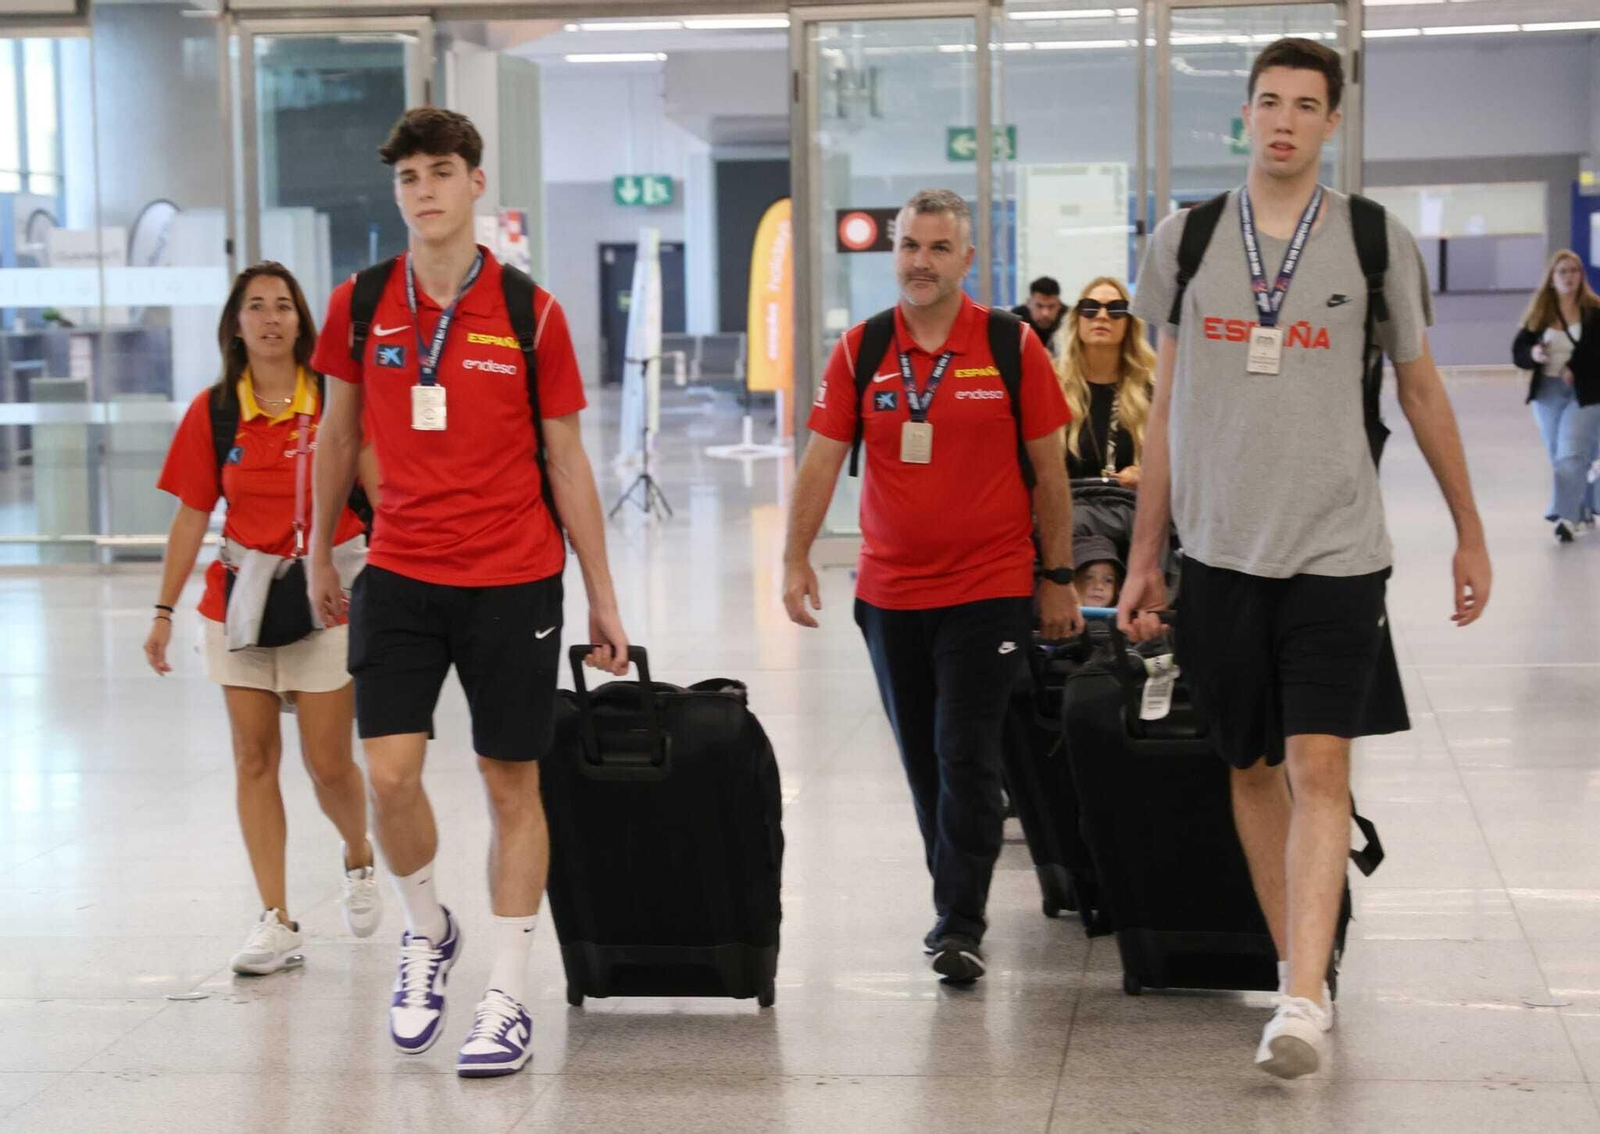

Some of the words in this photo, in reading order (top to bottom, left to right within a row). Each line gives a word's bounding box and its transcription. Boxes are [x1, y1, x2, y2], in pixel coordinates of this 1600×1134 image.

[1203, 316, 1331, 349] ESÑA
[462, 359, 517, 375] endesa
[954, 388, 1004, 400] endesa
